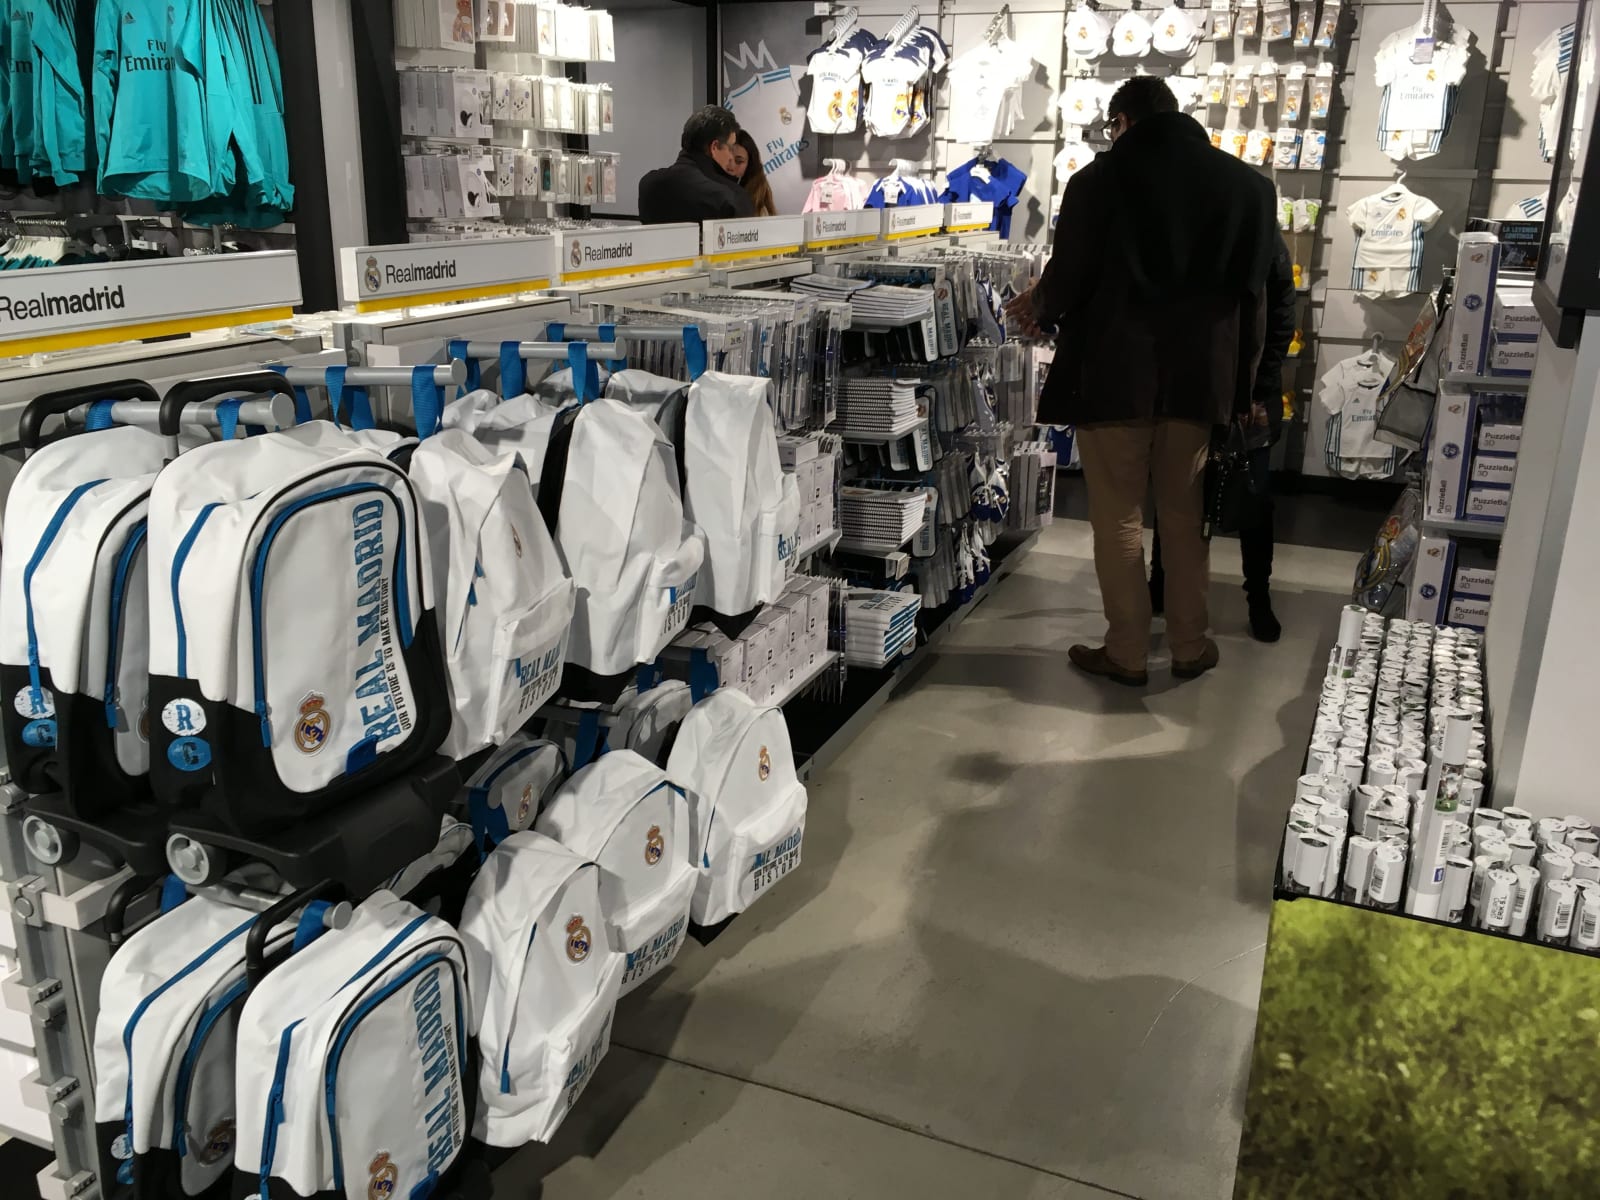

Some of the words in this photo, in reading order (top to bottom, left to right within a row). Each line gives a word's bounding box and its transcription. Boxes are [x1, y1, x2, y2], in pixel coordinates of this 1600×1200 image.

[147, 39, 167, 53] Fly
[763, 138, 810, 174] mirates
[766, 137, 784, 153] Fly
[726, 229, 759, 245] Realmadrid
[584, 242, 633, 262] Realmadrid
[386, 259, 457, 284] Realmadrid
[0, 285, 125, 321] Realmadrid
[352, 499, 384, 647] MADRID
[381, 577, 390, 617] HISTORY
[380, 618, 393, 647] MAKE
[384, 646, 394, 660] TO
[386, 661, 396, 674] IS
[355, 648, 402, 743] REAL
[388, 674, 406, 711] FUTURE
[175, 704, 195, 732] R
[399, 709, 412, 731] OUR
[754, 853, 799, 891] HISTORY
[412, 967, 450, 1097] MADRID
[425, 1085, 454, 1176] REAL
